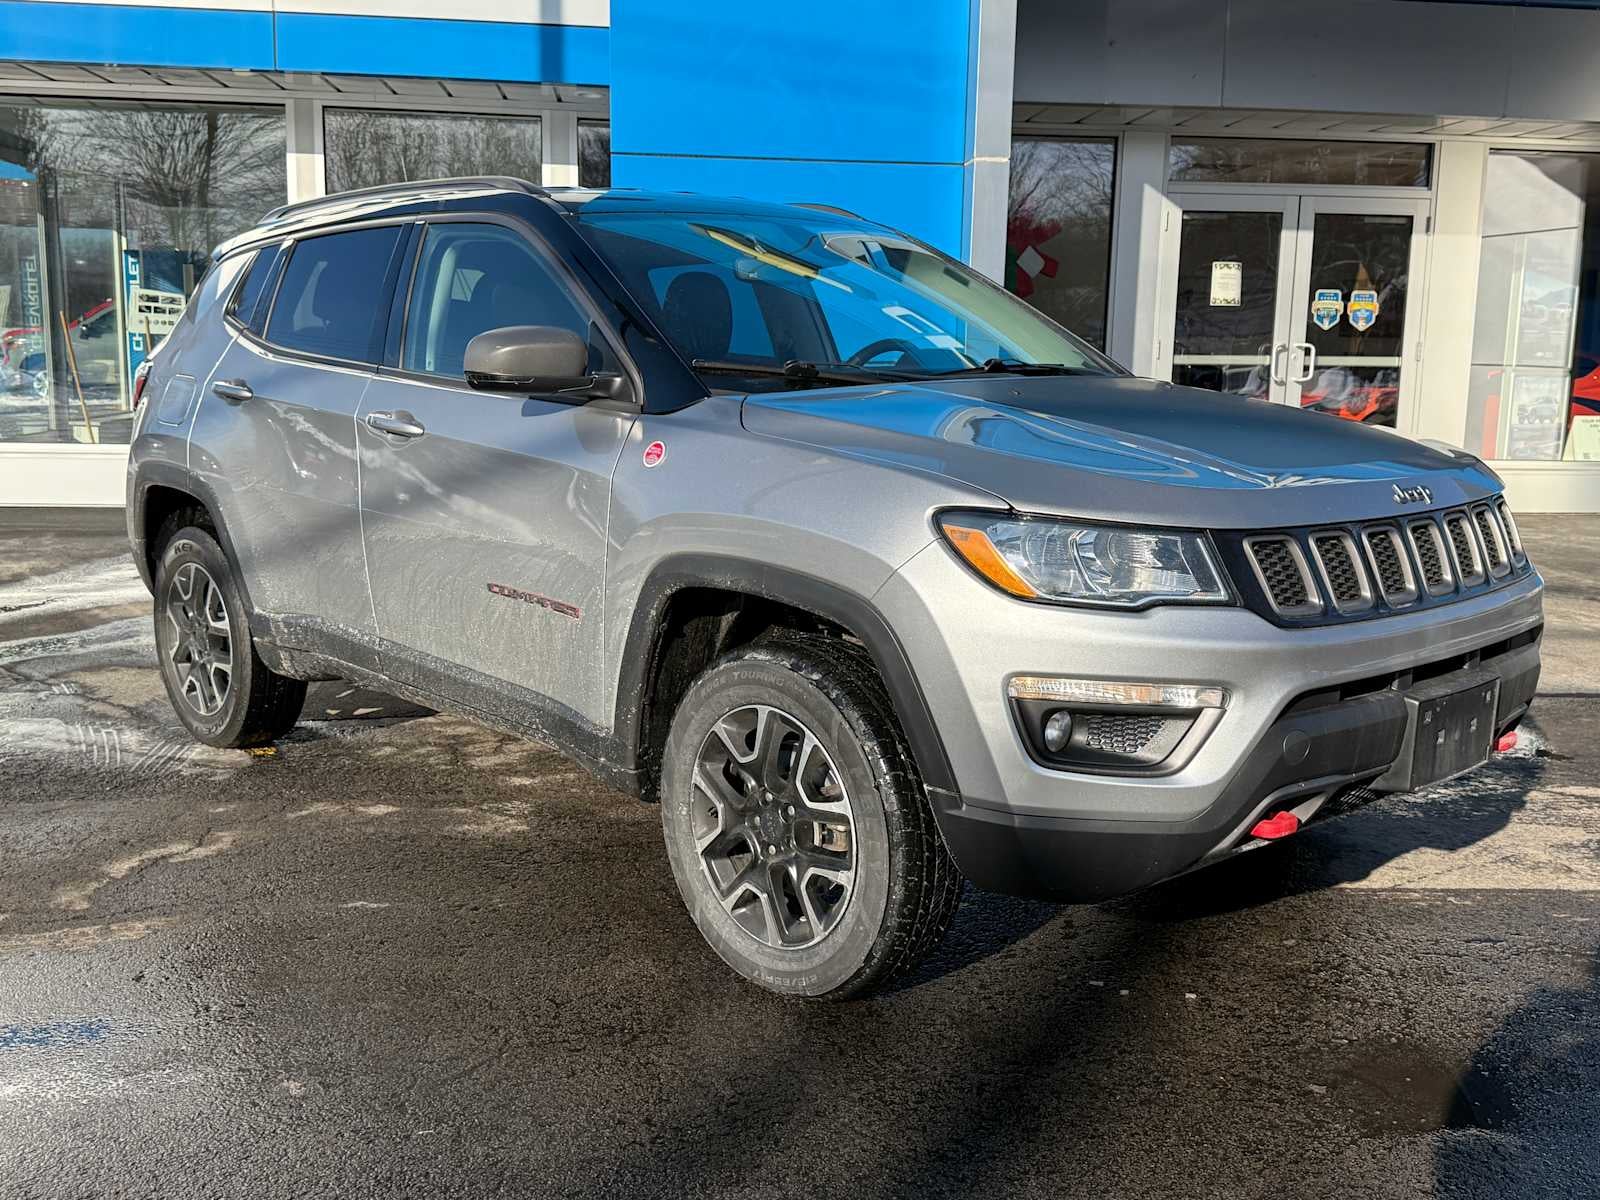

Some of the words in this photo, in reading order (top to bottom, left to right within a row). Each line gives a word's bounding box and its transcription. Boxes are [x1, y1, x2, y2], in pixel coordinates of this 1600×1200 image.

[128, 254, 144, 352] CHLET
[1392, 483, 1433, 505] Jeep
[733, 671, 785, 687] TOURING
